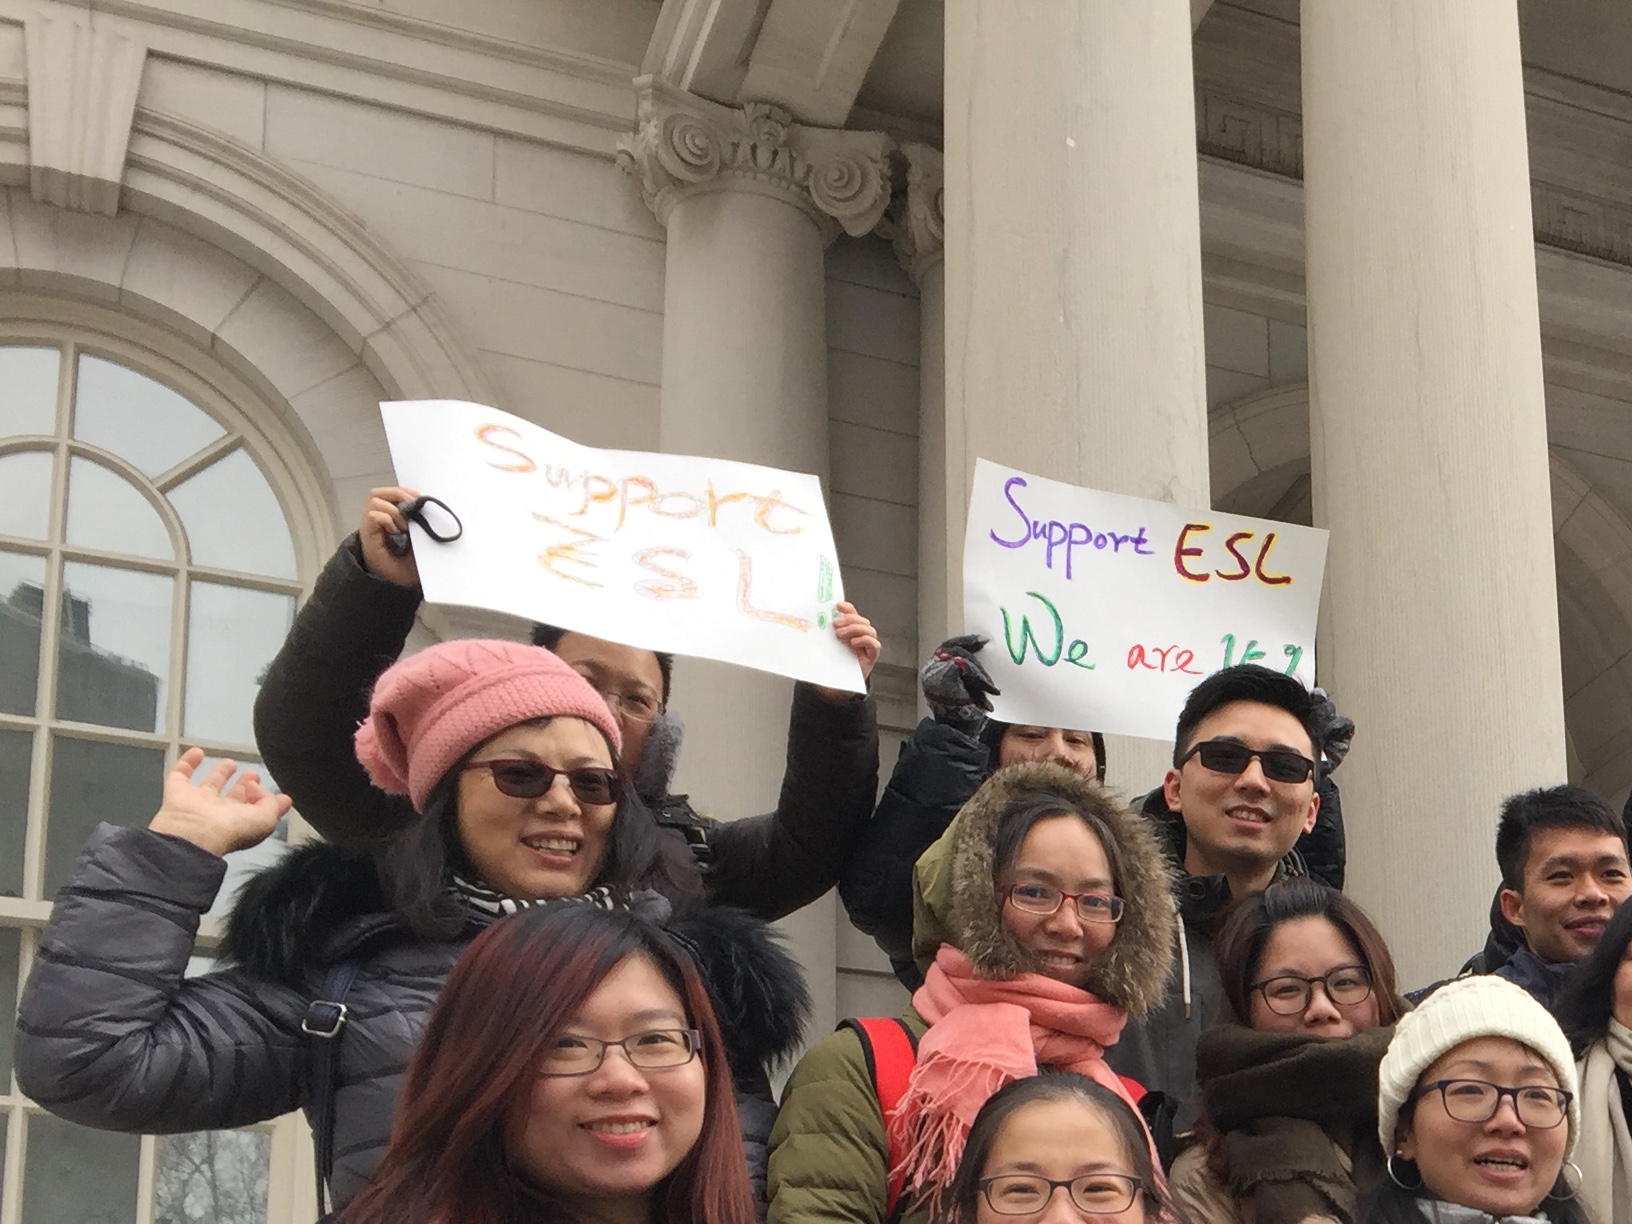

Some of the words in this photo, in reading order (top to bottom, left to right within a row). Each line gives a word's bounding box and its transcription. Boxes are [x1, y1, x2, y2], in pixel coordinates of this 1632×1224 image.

[475, 422, 812, 534] Support
[989, 476, 1156, 581] Support
[1173, 522, 1294, 587] ESL
[999, 591, 1097, 670] We
[1127, 643, 1205, 676] are
